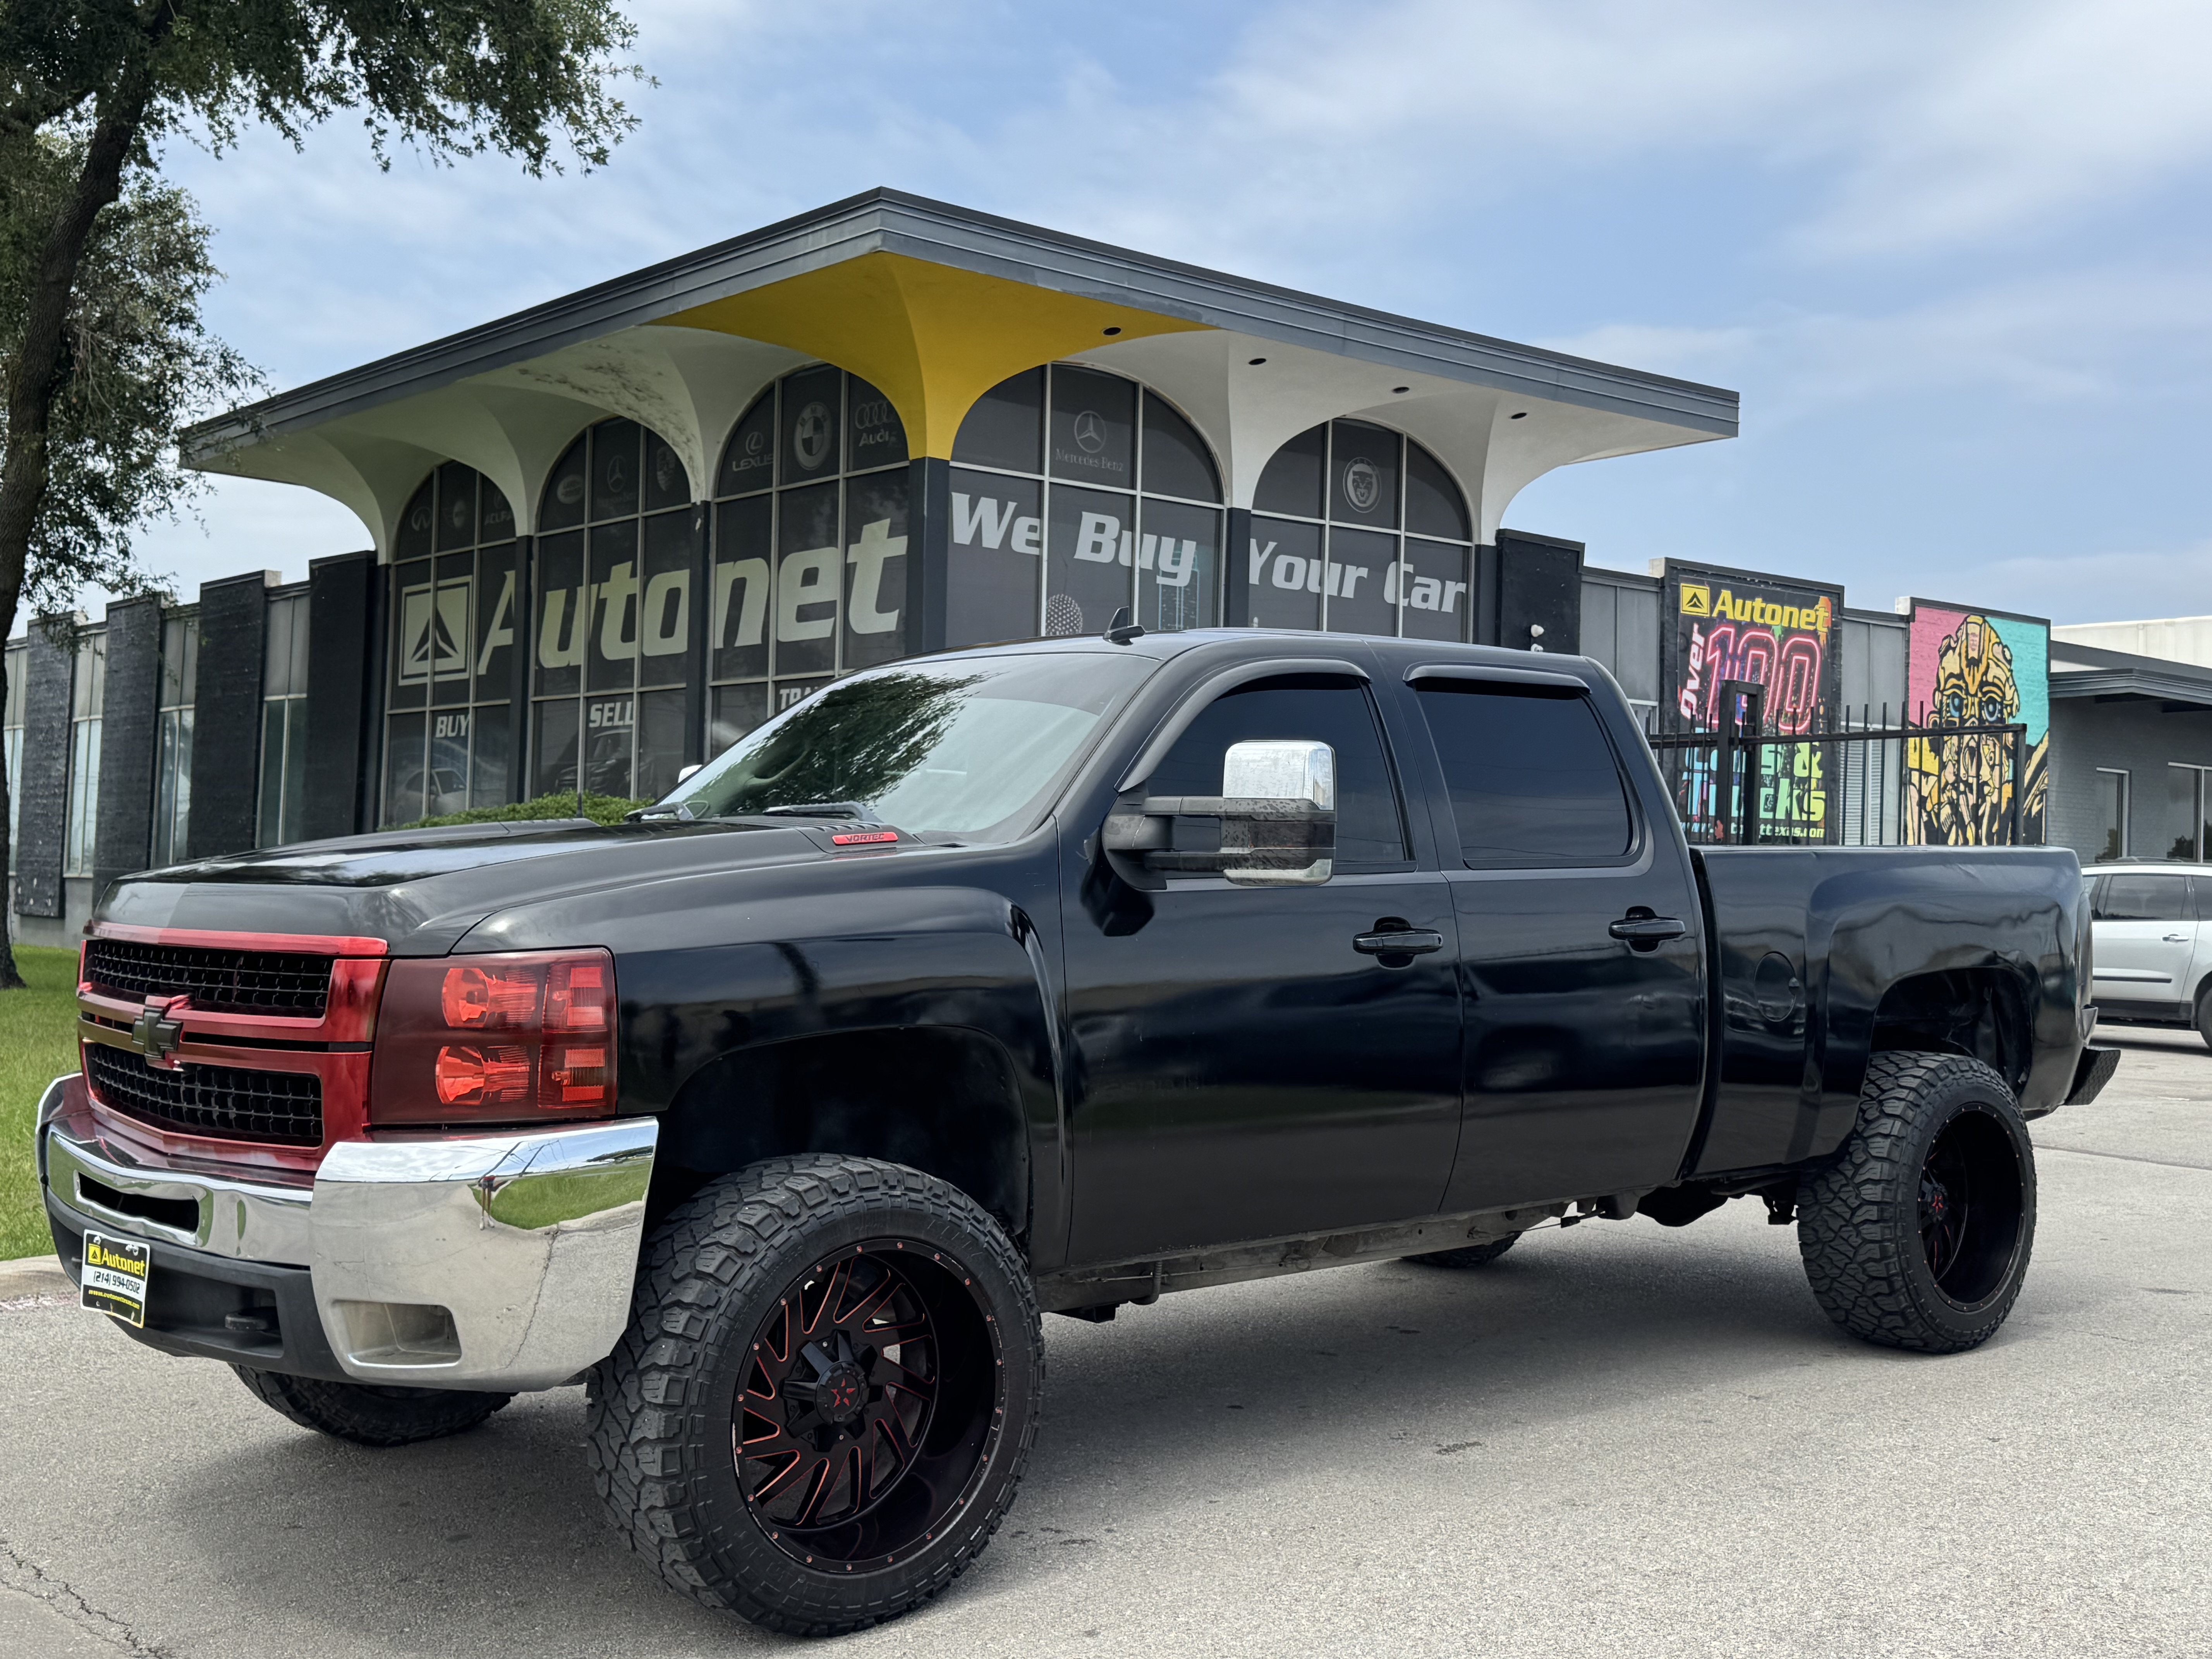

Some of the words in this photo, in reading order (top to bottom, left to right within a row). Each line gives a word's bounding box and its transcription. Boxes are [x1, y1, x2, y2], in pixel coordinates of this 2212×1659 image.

[859, 428, 889, 447] Audi
[732, 453, 774, 472] LEXUS
[1055, 448, 1099, 467] Mercedes
[1101, 456, 1124, 472] Benz
[951, 492, 1040, 556] We
[1073, 511, 1197, 587] Buy
[1249, 538, 1369, 599] Your
[1383, 561, 1467, 613] Car
[477, 518, 907, 675] Autonet
[1712, 589, 1829, 632] Autonet
[1680, 623, 1705, 720] over
[1706, 624, 1821, 732] 100
[436, 714, 470, 738] BUY
[589, 702, 634, 728] SELL
[845, 833, 884, 842] VORTEC
[101, 1248, 145, 1276] Autonet
[93, 1271, 111, 1286] (214)
[112, 1274, 141, 1294] 994-0502
